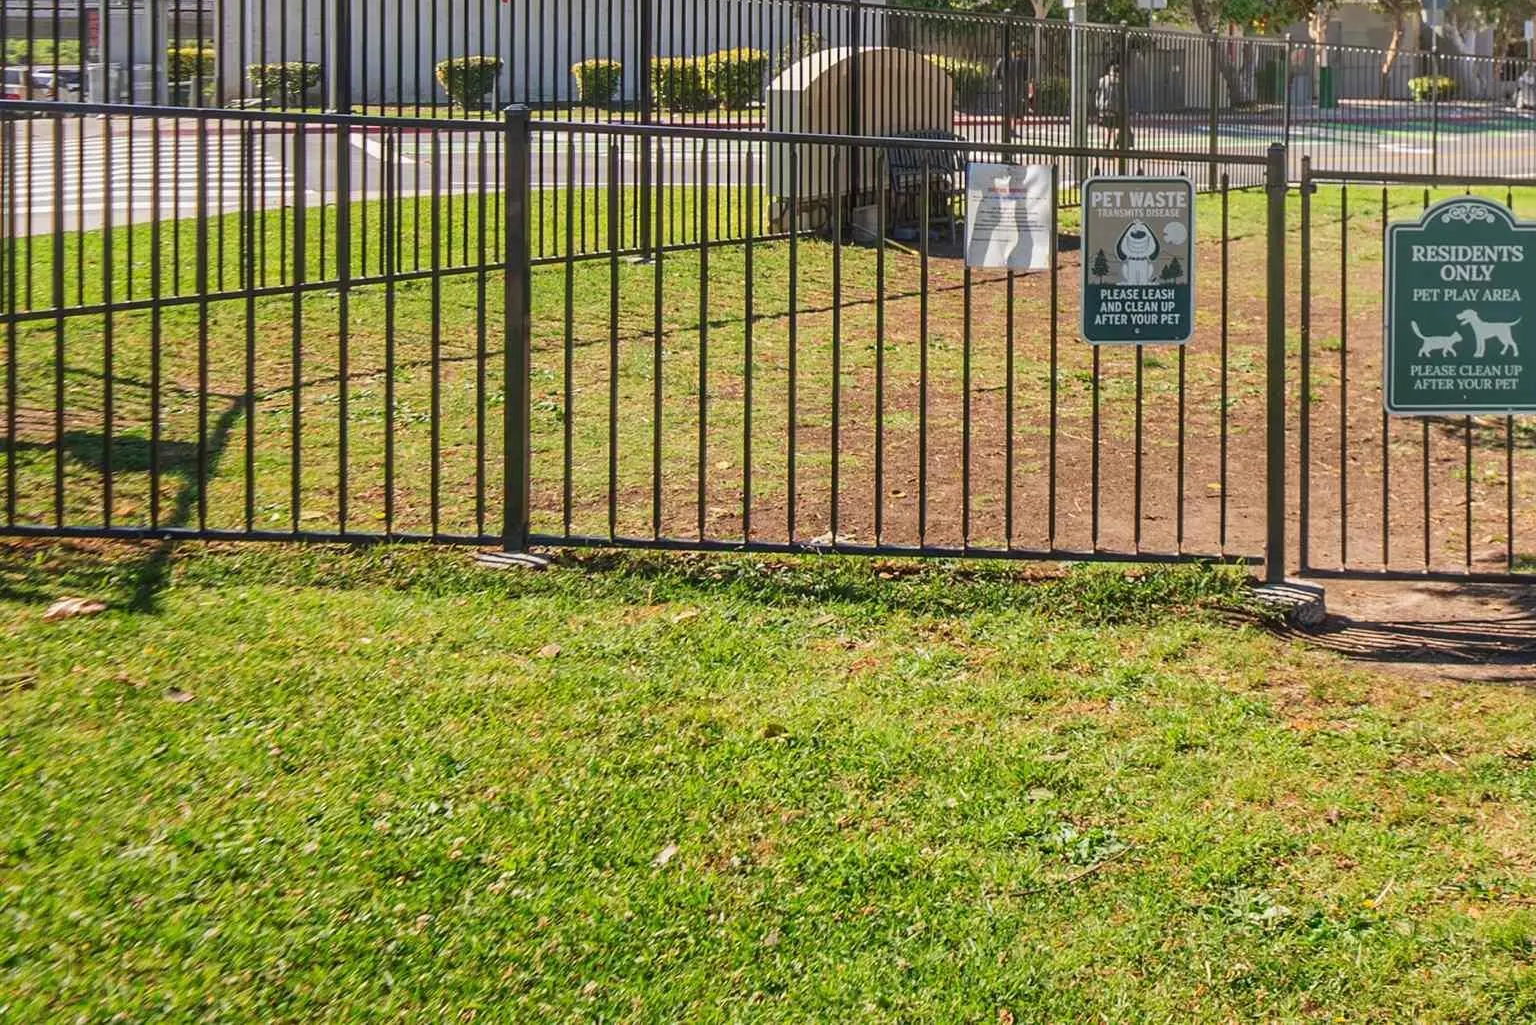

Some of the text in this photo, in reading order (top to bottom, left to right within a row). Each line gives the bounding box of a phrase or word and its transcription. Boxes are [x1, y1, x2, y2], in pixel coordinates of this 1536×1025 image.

[1092, 191, 1186, 208] PET WASTE
[1099, 208, 1180, 218] TRANSMITS DISEASE
[1412, 245, 1524, 262] RESIDENTS
[1440, 264, 1495, 281] ONLY
[1100, 289, 1175, 300] PLEASE LEASH
[1413, 289, 1521, 302] PET PLAY AREA
[1100, 301, 1176, 312] AND CLEAN UP
[1095, 314, 1180, 325] AFTER YOUR PET
[1410, 365, 1523, 376] PLEASE CLEAN UP
[1414, 378, 1520, 390] AFTER YOUR PET
